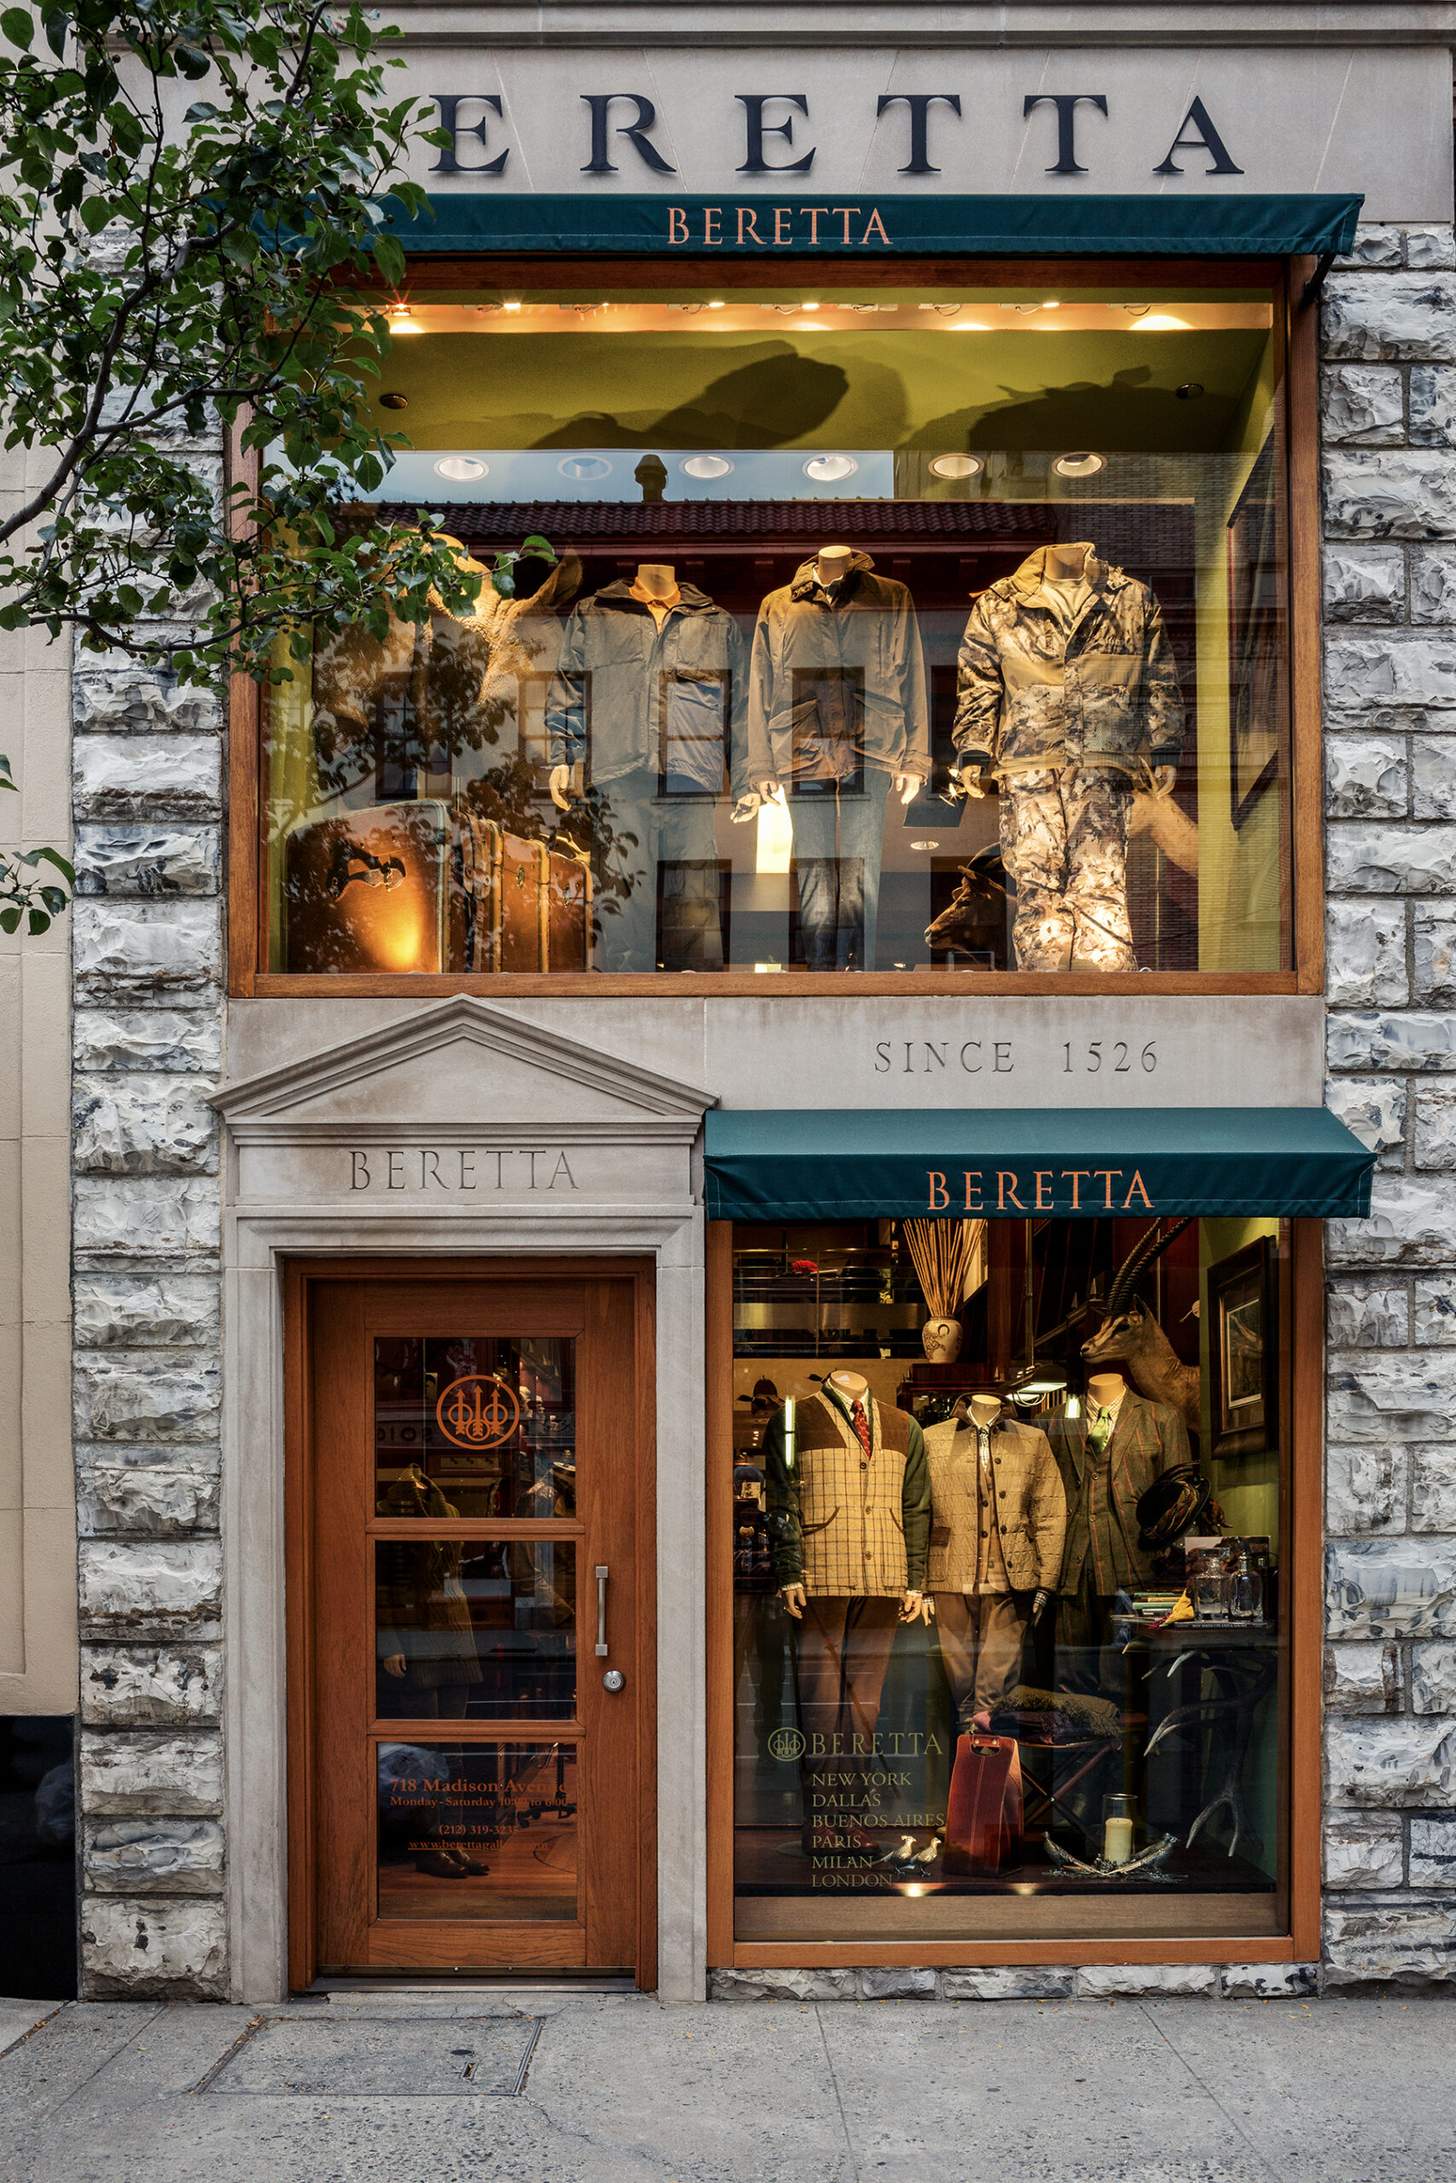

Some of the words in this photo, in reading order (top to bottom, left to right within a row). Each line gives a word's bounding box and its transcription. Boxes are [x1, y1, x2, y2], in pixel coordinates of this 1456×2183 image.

[290, 94, 1245, 174] ERETTA
[667, 207, 894, 246] BERETTA
[874, 1040, 1015, 1073] SINCE
[1062, 1040, 1158, 1073] 1526
[349, 1150, 579, 1190] BERETTA
[926, 1169, 1156, 1210] BERETTA
[811, 1732, 943, 1756] BERETTA
[390, 1778, 417, 1792] 718
[423, 1777, 500, 1792] Madison
[504, 1779, 566, 1792] Avene
[811, 1773, 856, 1786] NEW
[860, 1772, 912, 1786] YORK
[811, 1793, 881, 1807] DALLAS
[812, 1814, 888, 1828] BUENOS
[895, 1813, 945, 1827] AIRES
[439, 1825, 466, 1836] (212)
[811, 1835, 862, 1849] PARIS
[811, 1855, 873, 1869] MILAN
[811, 1874, 893, 1888] LONDON
